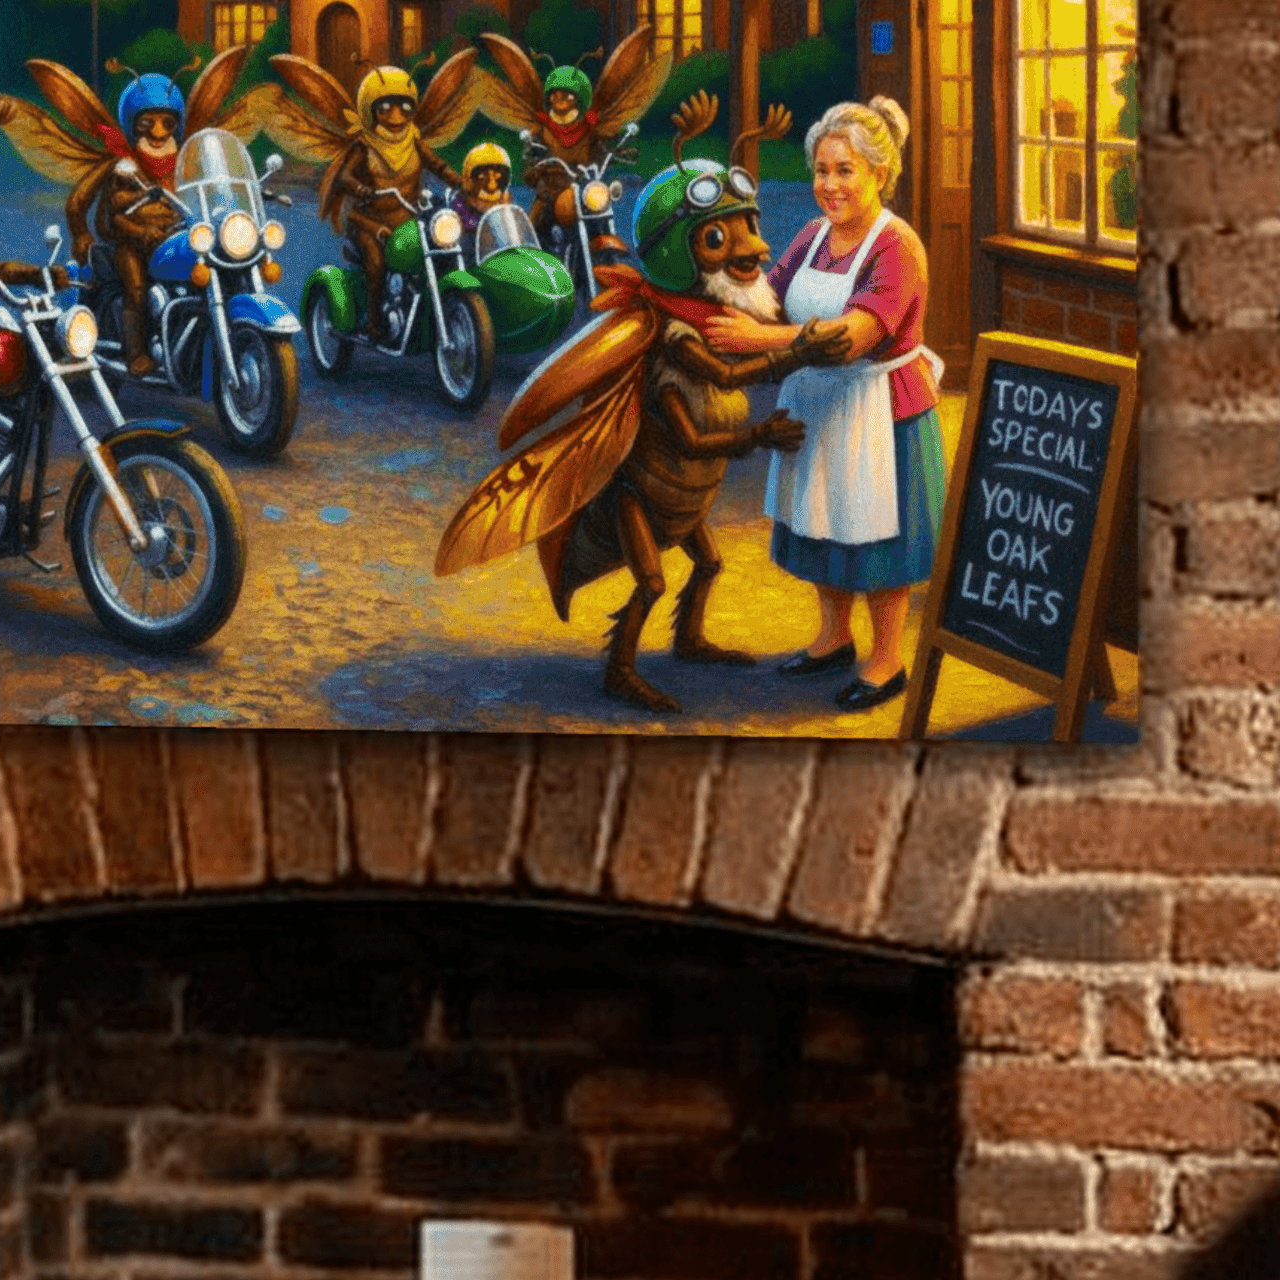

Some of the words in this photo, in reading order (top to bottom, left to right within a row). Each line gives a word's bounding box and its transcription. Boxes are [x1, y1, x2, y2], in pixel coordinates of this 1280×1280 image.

[988, 417, 1094, 473] SPECIAL
[980, 478, 1075, 537] YOUNG
[986, 528, 1052, 575] OAK
[960, 561, 1064, 626] LEAFS
